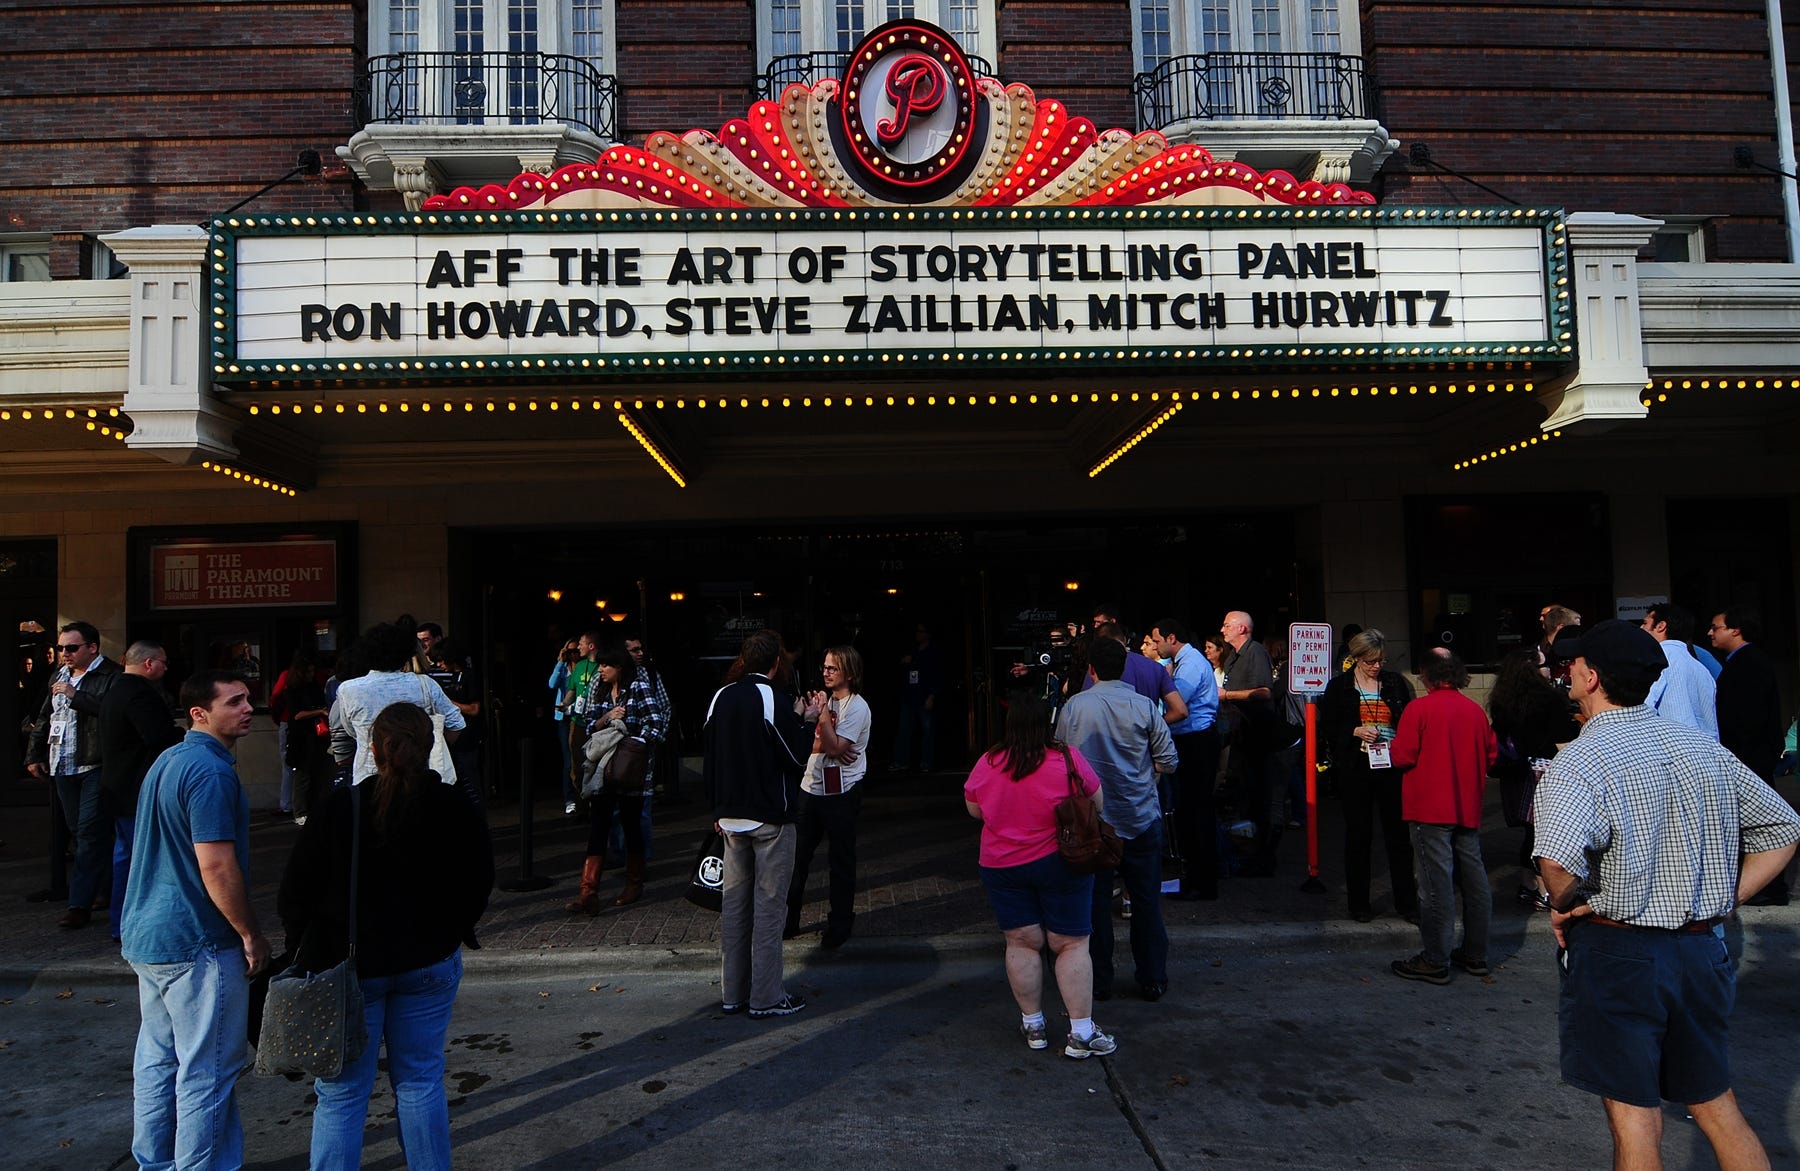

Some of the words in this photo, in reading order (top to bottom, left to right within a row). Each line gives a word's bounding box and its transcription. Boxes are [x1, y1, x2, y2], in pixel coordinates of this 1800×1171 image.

[427, 250, 523, 288] AFF
[551, 249, 641, 286] THE
[669, 248, 762, 286] ART
[790, 247, 847, 283] OF
[872, 245, 1202, 282] STORYTELLING
[1239, 243, 1376, 279] PANEL
[302, 304, 401, 342] RON
[429, 301, 653, 340] HOWARD,
[667, 298, 811, 335] STEVE
[844, 295, 1074, 334] ZAILLIAN,
[1090, 294, 1226, 331] MITCH
[1253, 292, 1453, 328] HURWITZ
[206, 554, 241, 568] THE
[207, 568, 322, 583] PARAMOUNT
[206, 584, 291, 599] THEATRE
[1296, 631, 1324, 640] PARKING
[1292, 642, 1301, 651] BY
[1305, 642, 1328, 651] PERMIT
[1302, 654, 1319, 663] ONLY
[1293, 666, 1327, 675] TOW-AWAY
